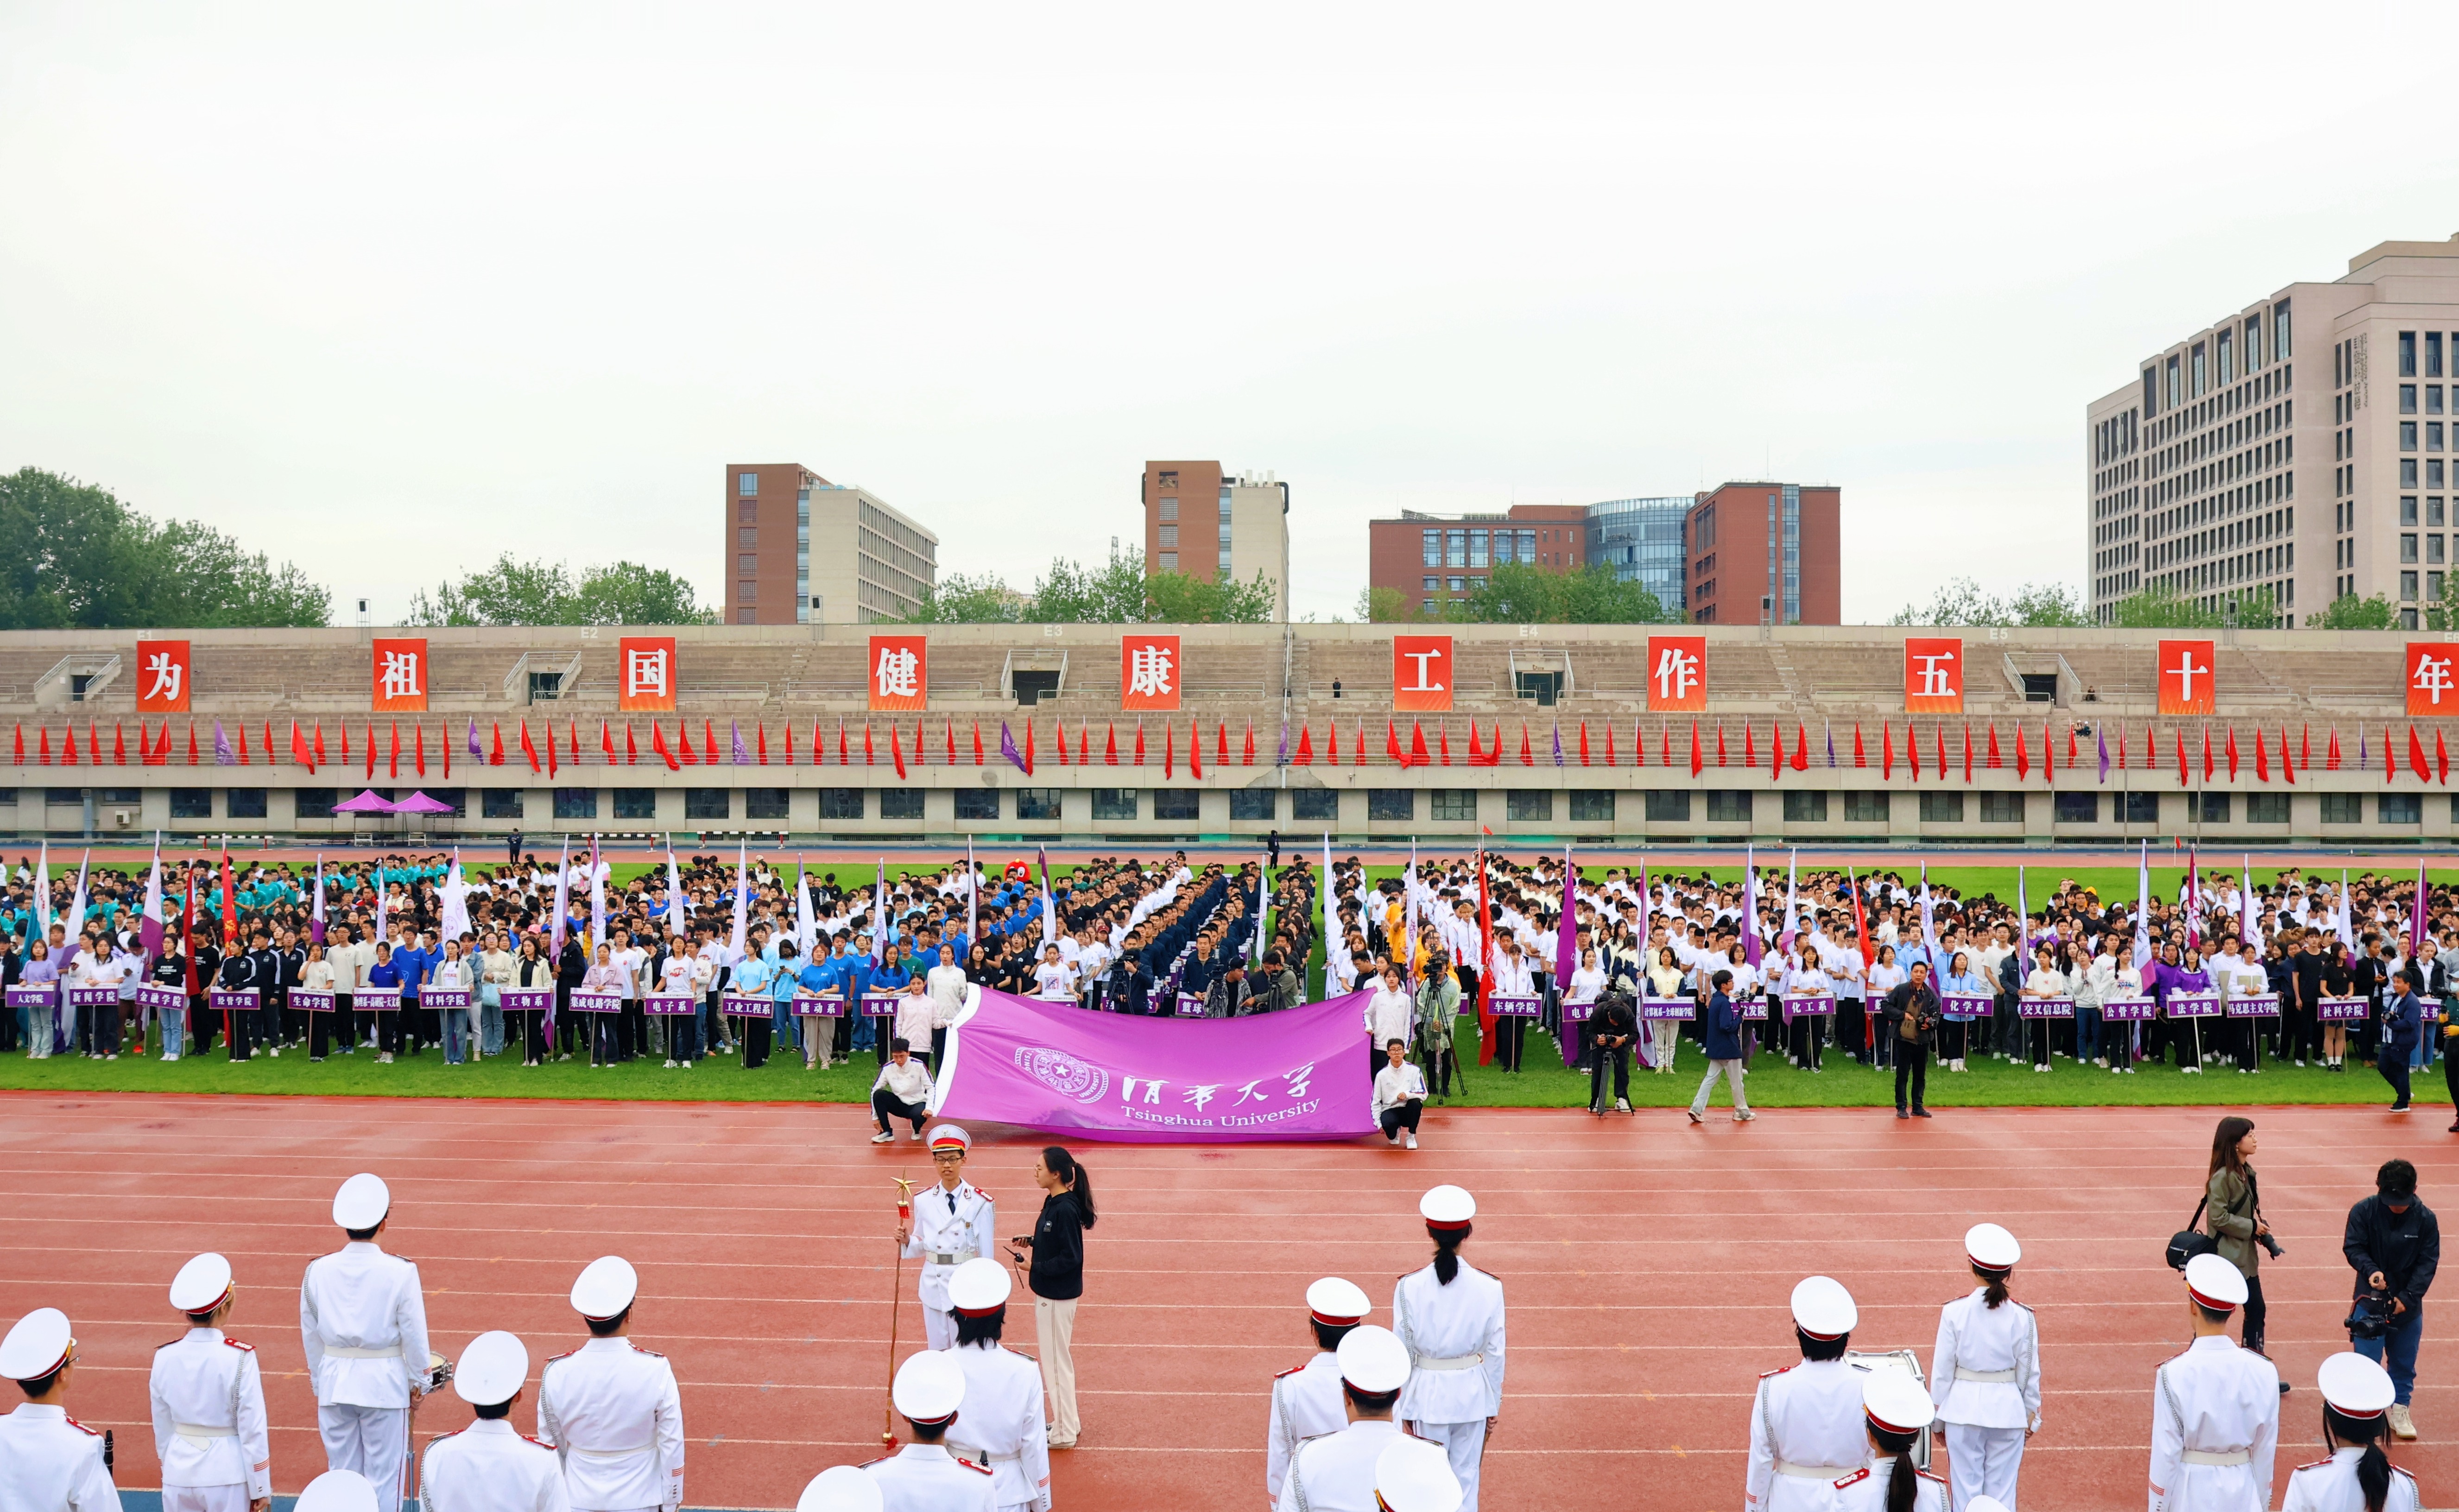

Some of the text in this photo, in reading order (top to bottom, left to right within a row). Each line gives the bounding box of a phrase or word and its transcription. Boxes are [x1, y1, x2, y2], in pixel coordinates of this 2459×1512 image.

[137, 630, 152, 640] E1
[581, 627, 598, 639] E2
[1044, 625, 1063, 637] E3
[1519, 625, 1538, 637] E4
[1990, 628, 2008, 640] E5
[145, 646, 2453, 704] 为 祖 国 健 康 工 作 五 十 年
[18, 995, 43, 1003] 人文学院
[73, 991, 115, 1002] 新闻学院
[140, 991, 181, 1007] 金融学院
[218, 996, 252, 1006] 经管学院
[293, 996, 330, 1009] 生命学院
[425, 995, 465, 1006] 材料学院
[509, 996, 543, 1006] 工物系
[570, 997, 620, 1010] 集成电路学院
[653, 1001, 686, 1012] 电子系
[725, 1002, 770, 1015] 工业工程系
[801, 1003, 835, 1014] 能动系
[1182, 1002, 1202, 1014] 篮球
[1494, 1001, 1536, 1013] 车辆学院
[1792, 1001, 1827, 1013] 化工系
[1950, 1000, 1984, 1012] 化学系
[2024, 1003, 2071, 1015] 交叉信息院
[2177, 1002, 2212, 1014] 法学院
[2228, 1001, 2279, 1014] 马克思主义学院
[1644, 1007, 1693, 1018] 计算机系-全球创新学院
[2107, 1005, 2151, 1017] 公管学院
[2323, 1005, 2363, 1017] 社科学院
[1078, 1071, 1100, 1098] UNIVERSITY
[1121, 1098, 1320, 1127] Tsinghua University
